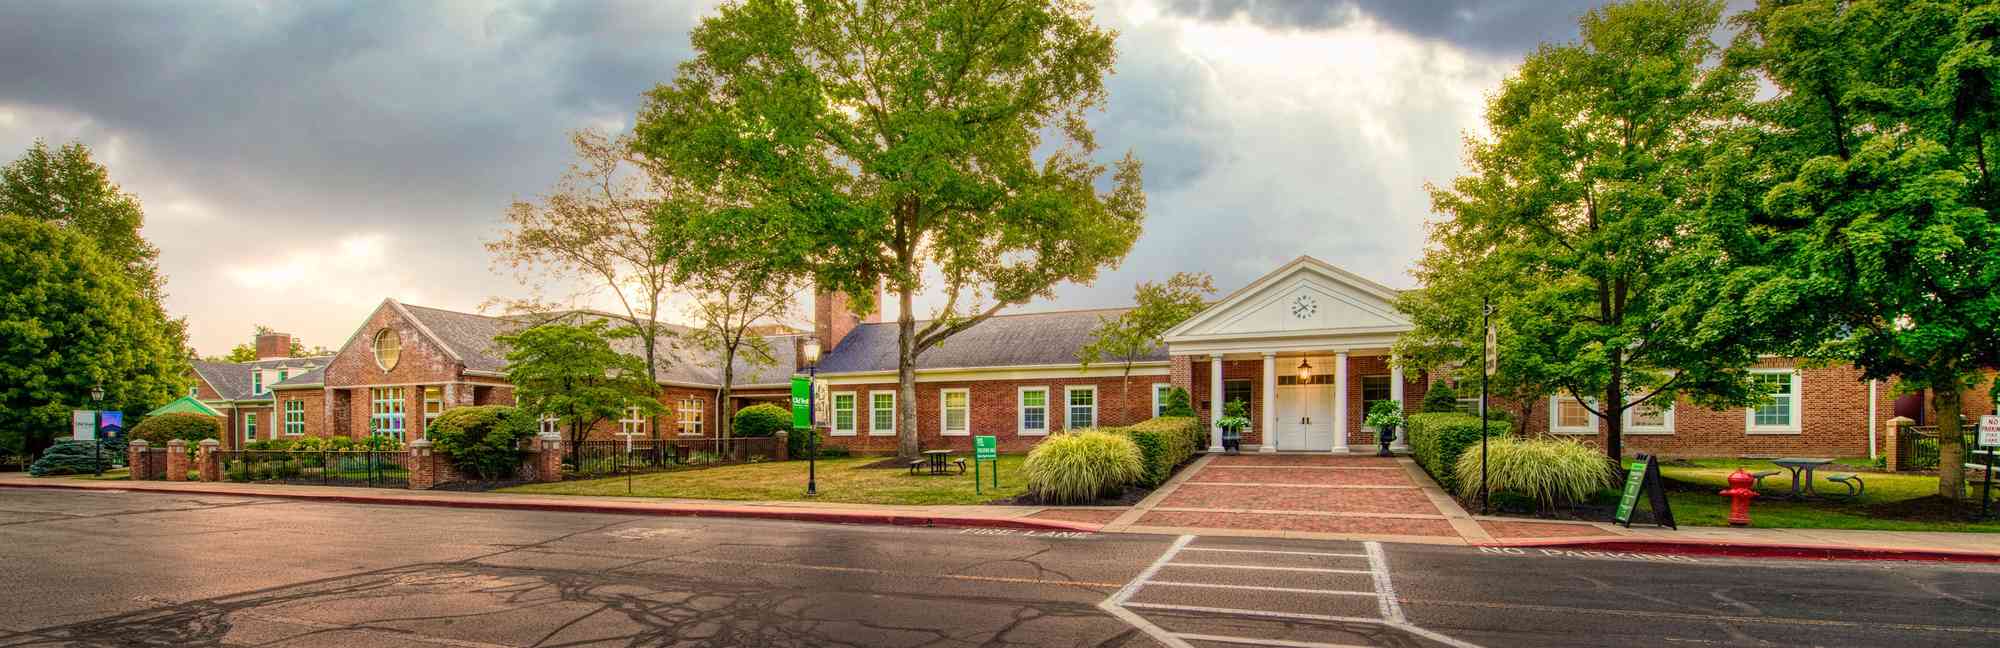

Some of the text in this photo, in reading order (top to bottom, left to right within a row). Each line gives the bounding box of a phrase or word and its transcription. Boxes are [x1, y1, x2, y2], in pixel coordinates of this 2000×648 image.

[959, 527, 1094, 538] FIRE LANE
[1478, 546, 1699, 562] NO PARKING
